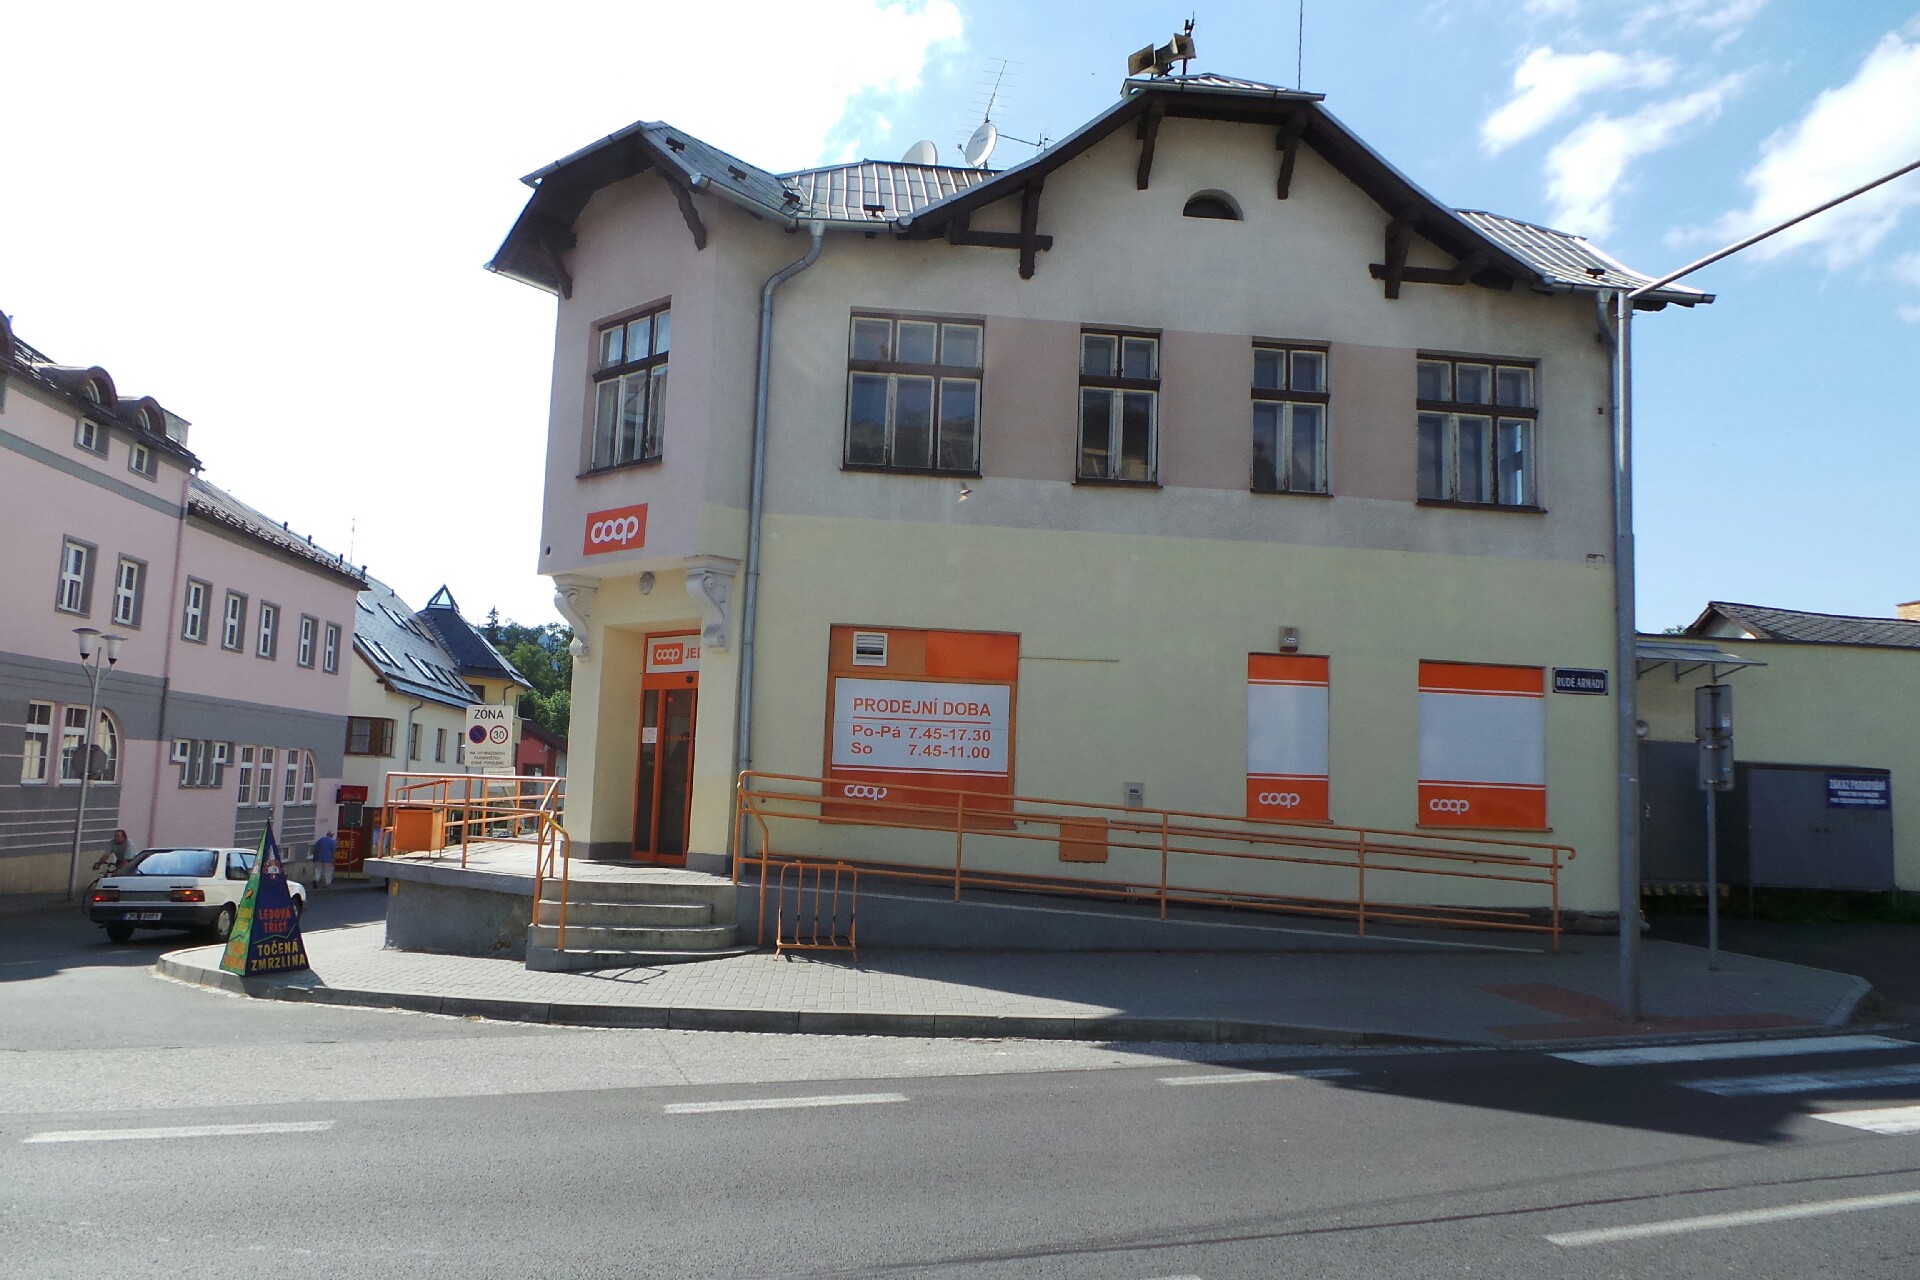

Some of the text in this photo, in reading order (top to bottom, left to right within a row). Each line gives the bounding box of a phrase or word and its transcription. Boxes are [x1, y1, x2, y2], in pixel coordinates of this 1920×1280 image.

[590, 515, 639, 545] coop
[655, 647, 680, 663] coop
[1556, 675, 1576, 688] RUDÉ
[474, 707, 505, 720] ZÓNA
[853, 697, 991, 717] PRODEJNÍ DOBA
[493, 731, 505, 740] 30
[852, 724, 991, 742] Po-Pá 7.45-17.30
[851, 741, 991, 759] So 7.45-11.00
[844, 784, 888, 801] coop
[1259, 792, 1300, 809] coop
[1429, 798, 1470, 815] coop
[257, 939, 299, 956] TOČENÁ
[251, 953, 306, 972] ZMRZLINA
